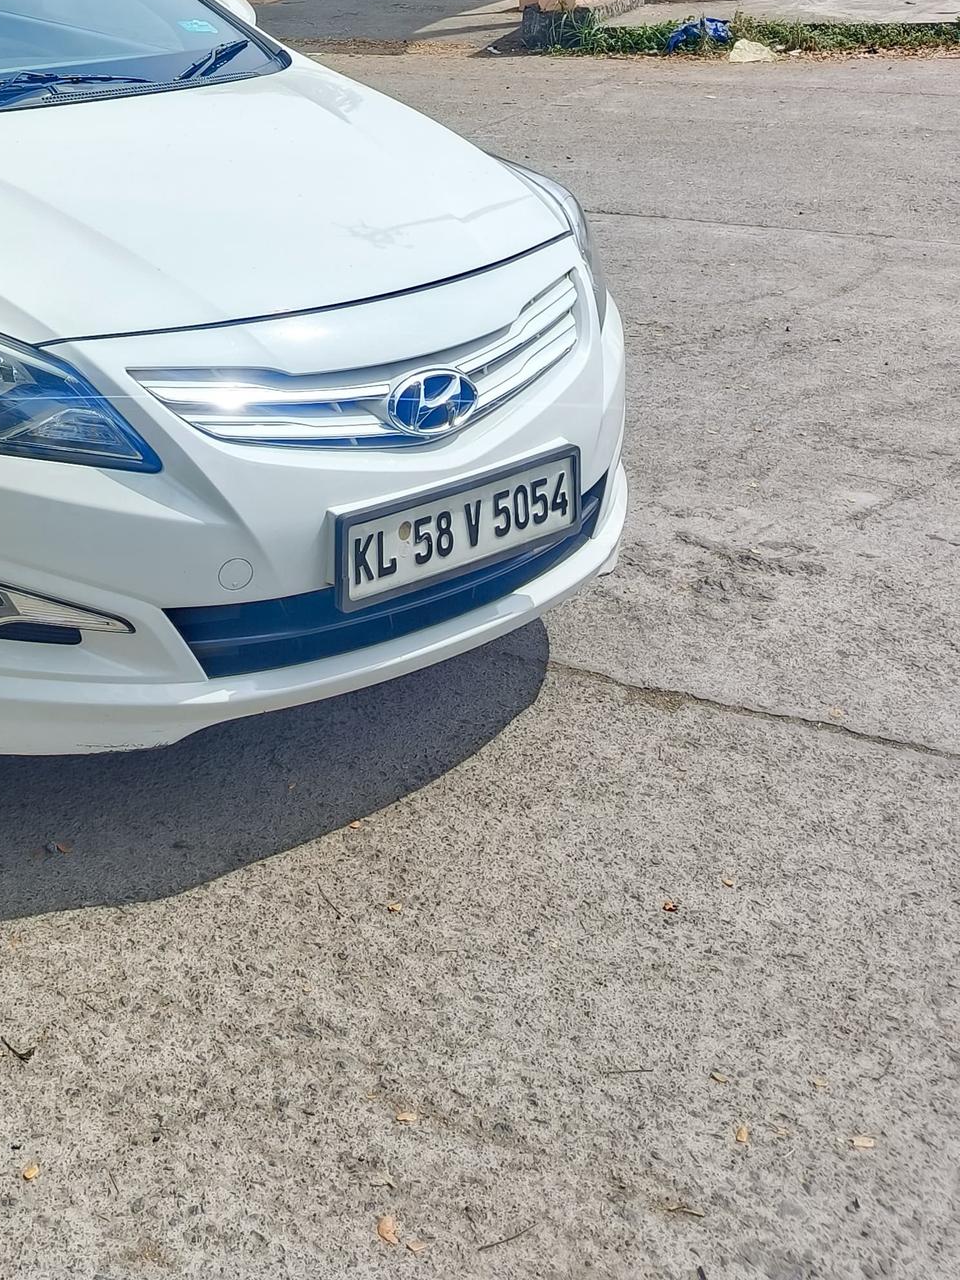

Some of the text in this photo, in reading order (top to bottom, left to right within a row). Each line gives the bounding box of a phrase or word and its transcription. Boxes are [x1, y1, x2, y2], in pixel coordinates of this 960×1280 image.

[354, 472, 568, 585] KL 58 V 5054
